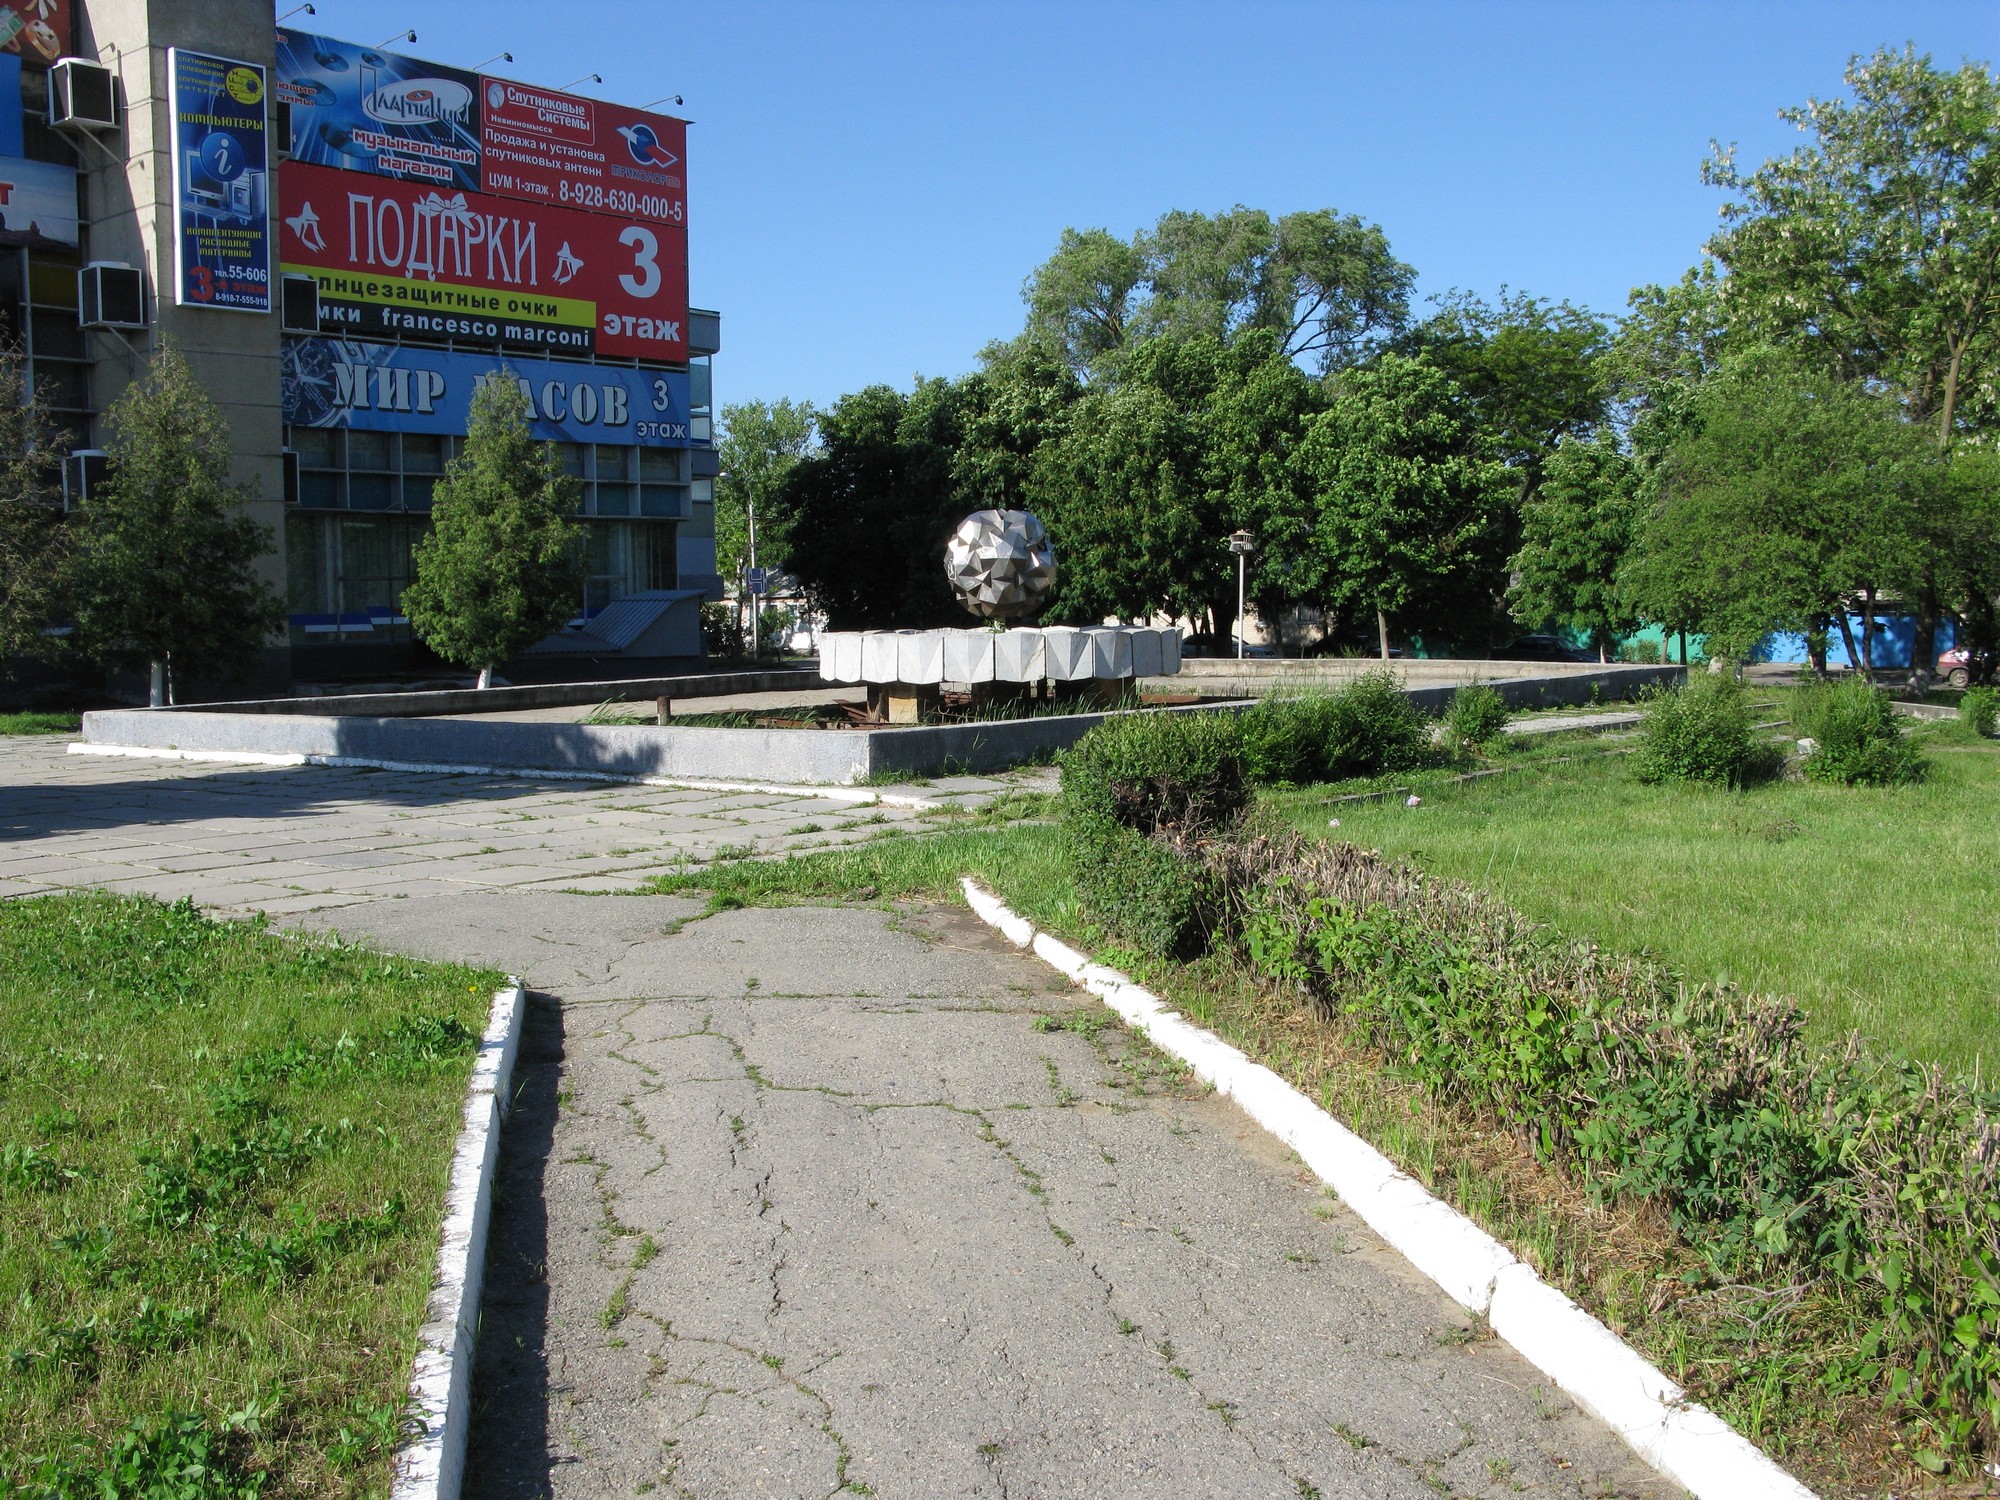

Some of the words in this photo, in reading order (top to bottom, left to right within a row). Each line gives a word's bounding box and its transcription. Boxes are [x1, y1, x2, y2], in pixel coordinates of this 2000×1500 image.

[178, 56, 225, 70] СПУТНИКОВОЕ
[178, 65, 225, 78] ТЕЛЕВИДЕНИЕ
[178, 86, 226, 97] ИНТЕРНЕТ
[276, 82, 317, 96] ющие
[507, 86, 585, 116] Спутниковые
[179, 112, 263, 130] КОМПЬЮТЕРЫ
[491, 114, 553, 134] Невинномысск
[537, 108, 590, 130] Системы
[353, 129, 476, 165] музыкальный
[485, 128, 537, 149] Продажа
[540, 140, 547, 151] и
[550, 143, 605, 162] установка
[379, 154, 453, 180] магазин
[485, 147, 561, 170] спутниковых
[564, 160, 602, 177] антенн
[489, 172, 512, 190] ЦУМ
[559, 180, 682, 222] 8-928-630-000-5
[186, 228, 263, 239] КОМПЛЕКТУЮЩИЕ
[200, 238, 251, 248] РАСХОДНЫЕ
[348, 192, 538, 286] ПОДАРКИ
[200, 248, 251, 258] МАТЕРИАЛЫ
[618, 226, 662, 298] 3
[229, 265, 267, 282] 55-606
[215, 293, 268, 306] 8-918-7-555-918
[310, 275, 500, 311] лнцезащитные
[508, 298, 558, 317] очки
[318, 304, 361, 323] мки
[382, 308, 497, 337] francesco
[505, 325, 589, 346] marconi
[603, 313, 681, 342] этаж
[332, 363, 446, 414] МИР
[473, 374, 628, 426] АСОВ
[652, 378, 669, 412] 3
[636, 421, 687, 439] этаж
